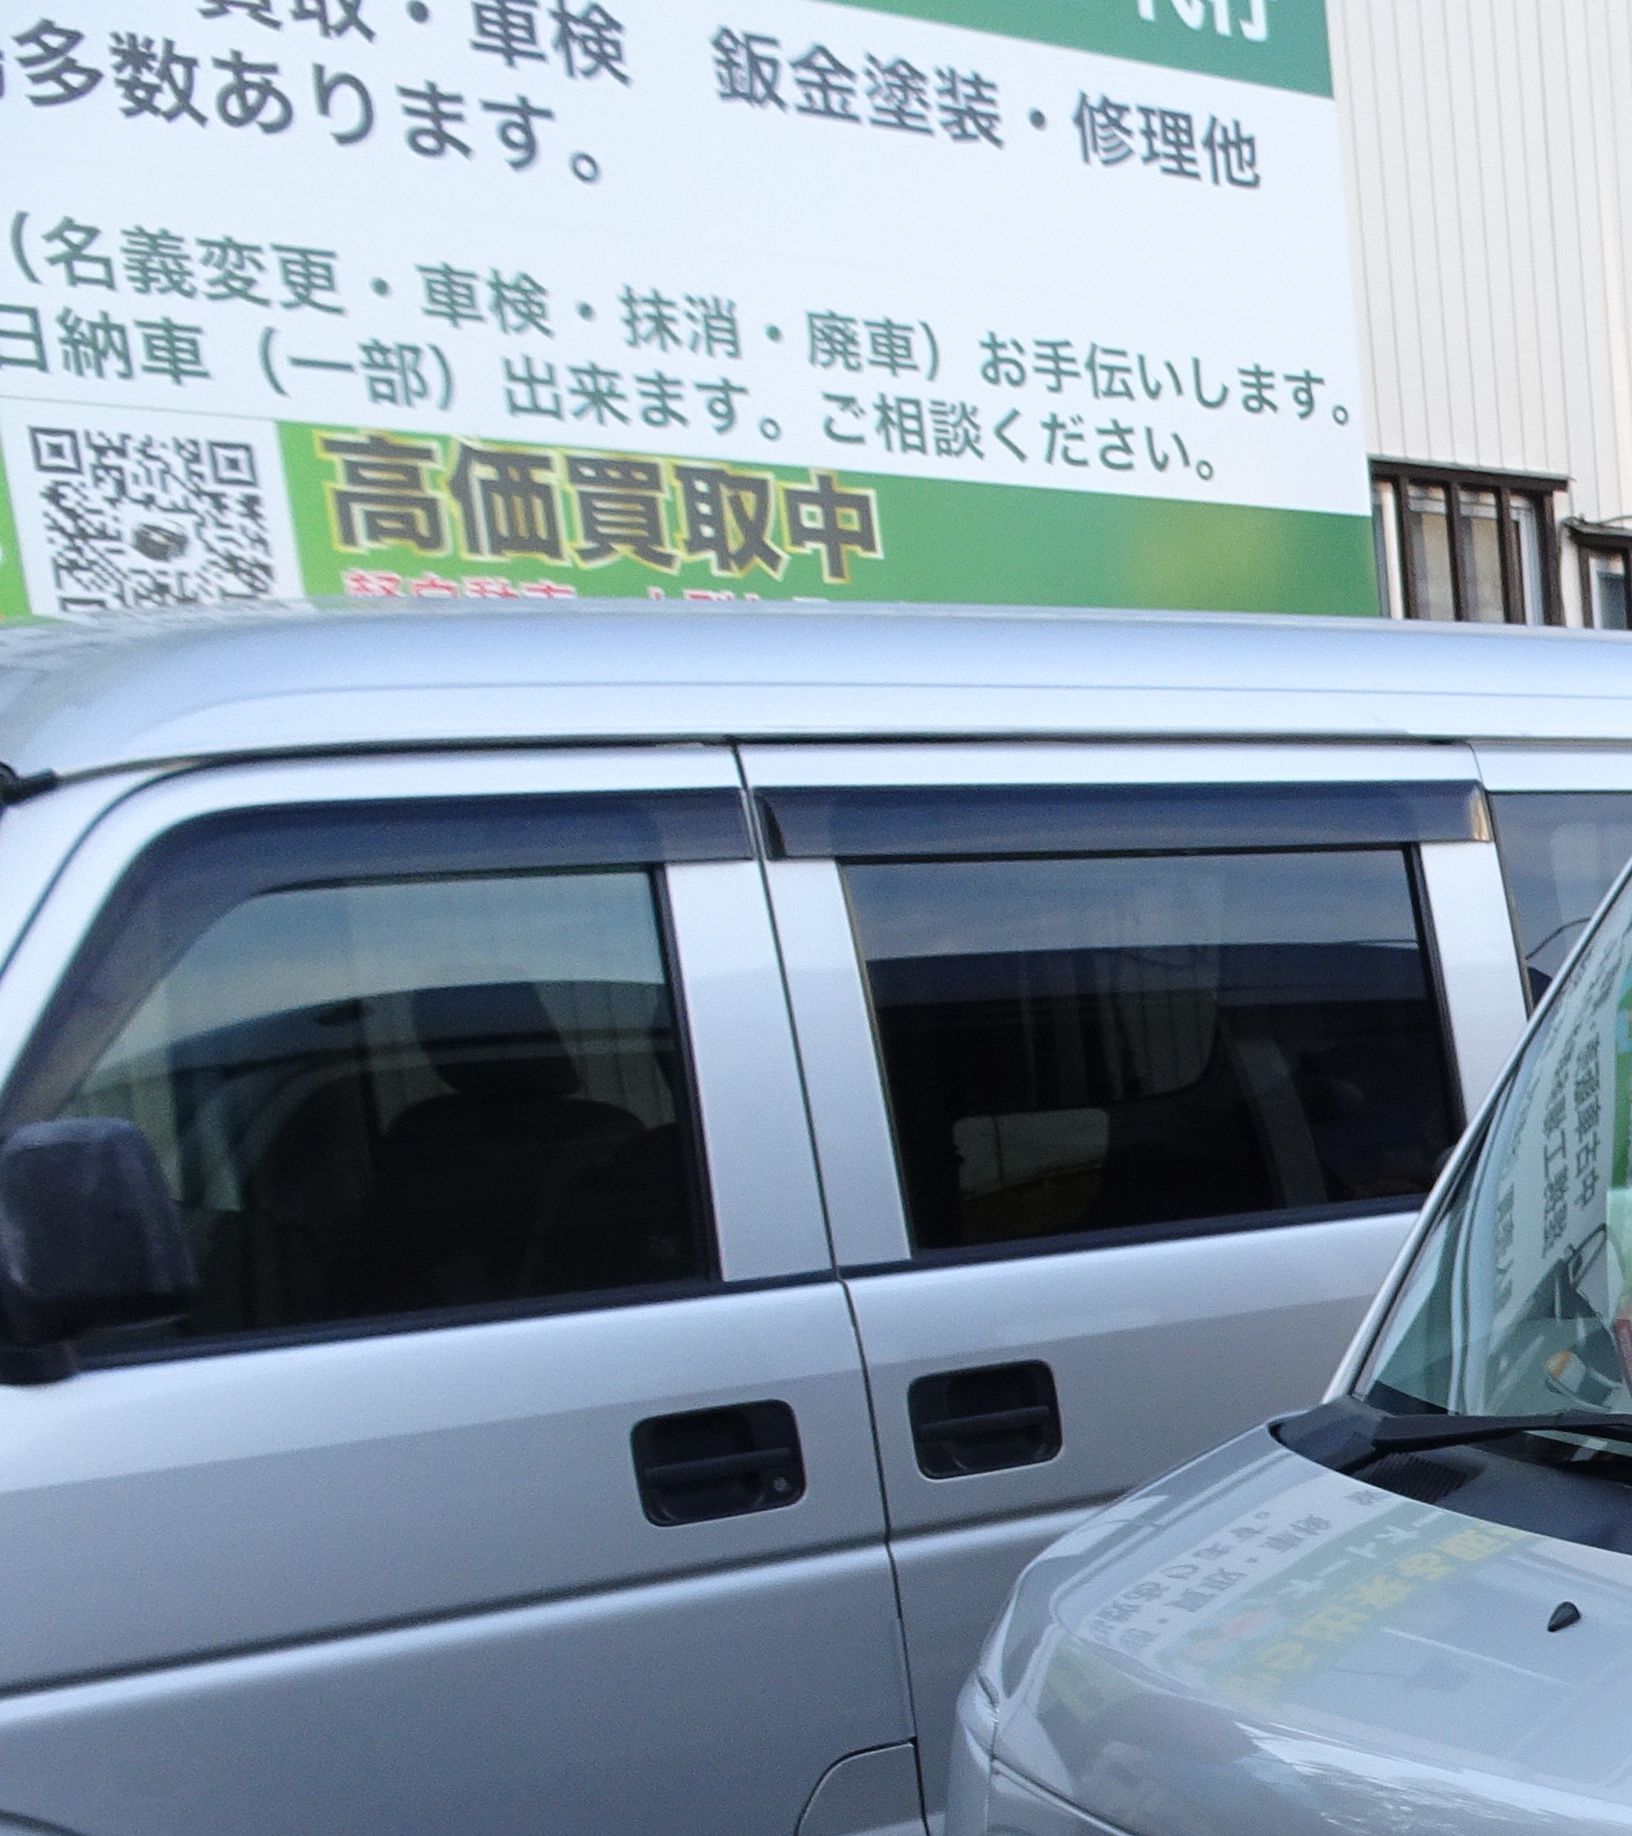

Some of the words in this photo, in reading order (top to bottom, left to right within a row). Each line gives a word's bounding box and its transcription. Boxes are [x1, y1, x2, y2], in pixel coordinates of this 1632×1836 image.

[0, 18, 603, 185] 多数あります。
[711, 27, 1262, 190] 鈑金塗装・修理他
[314, 429, 885, 585] 高価買取中
